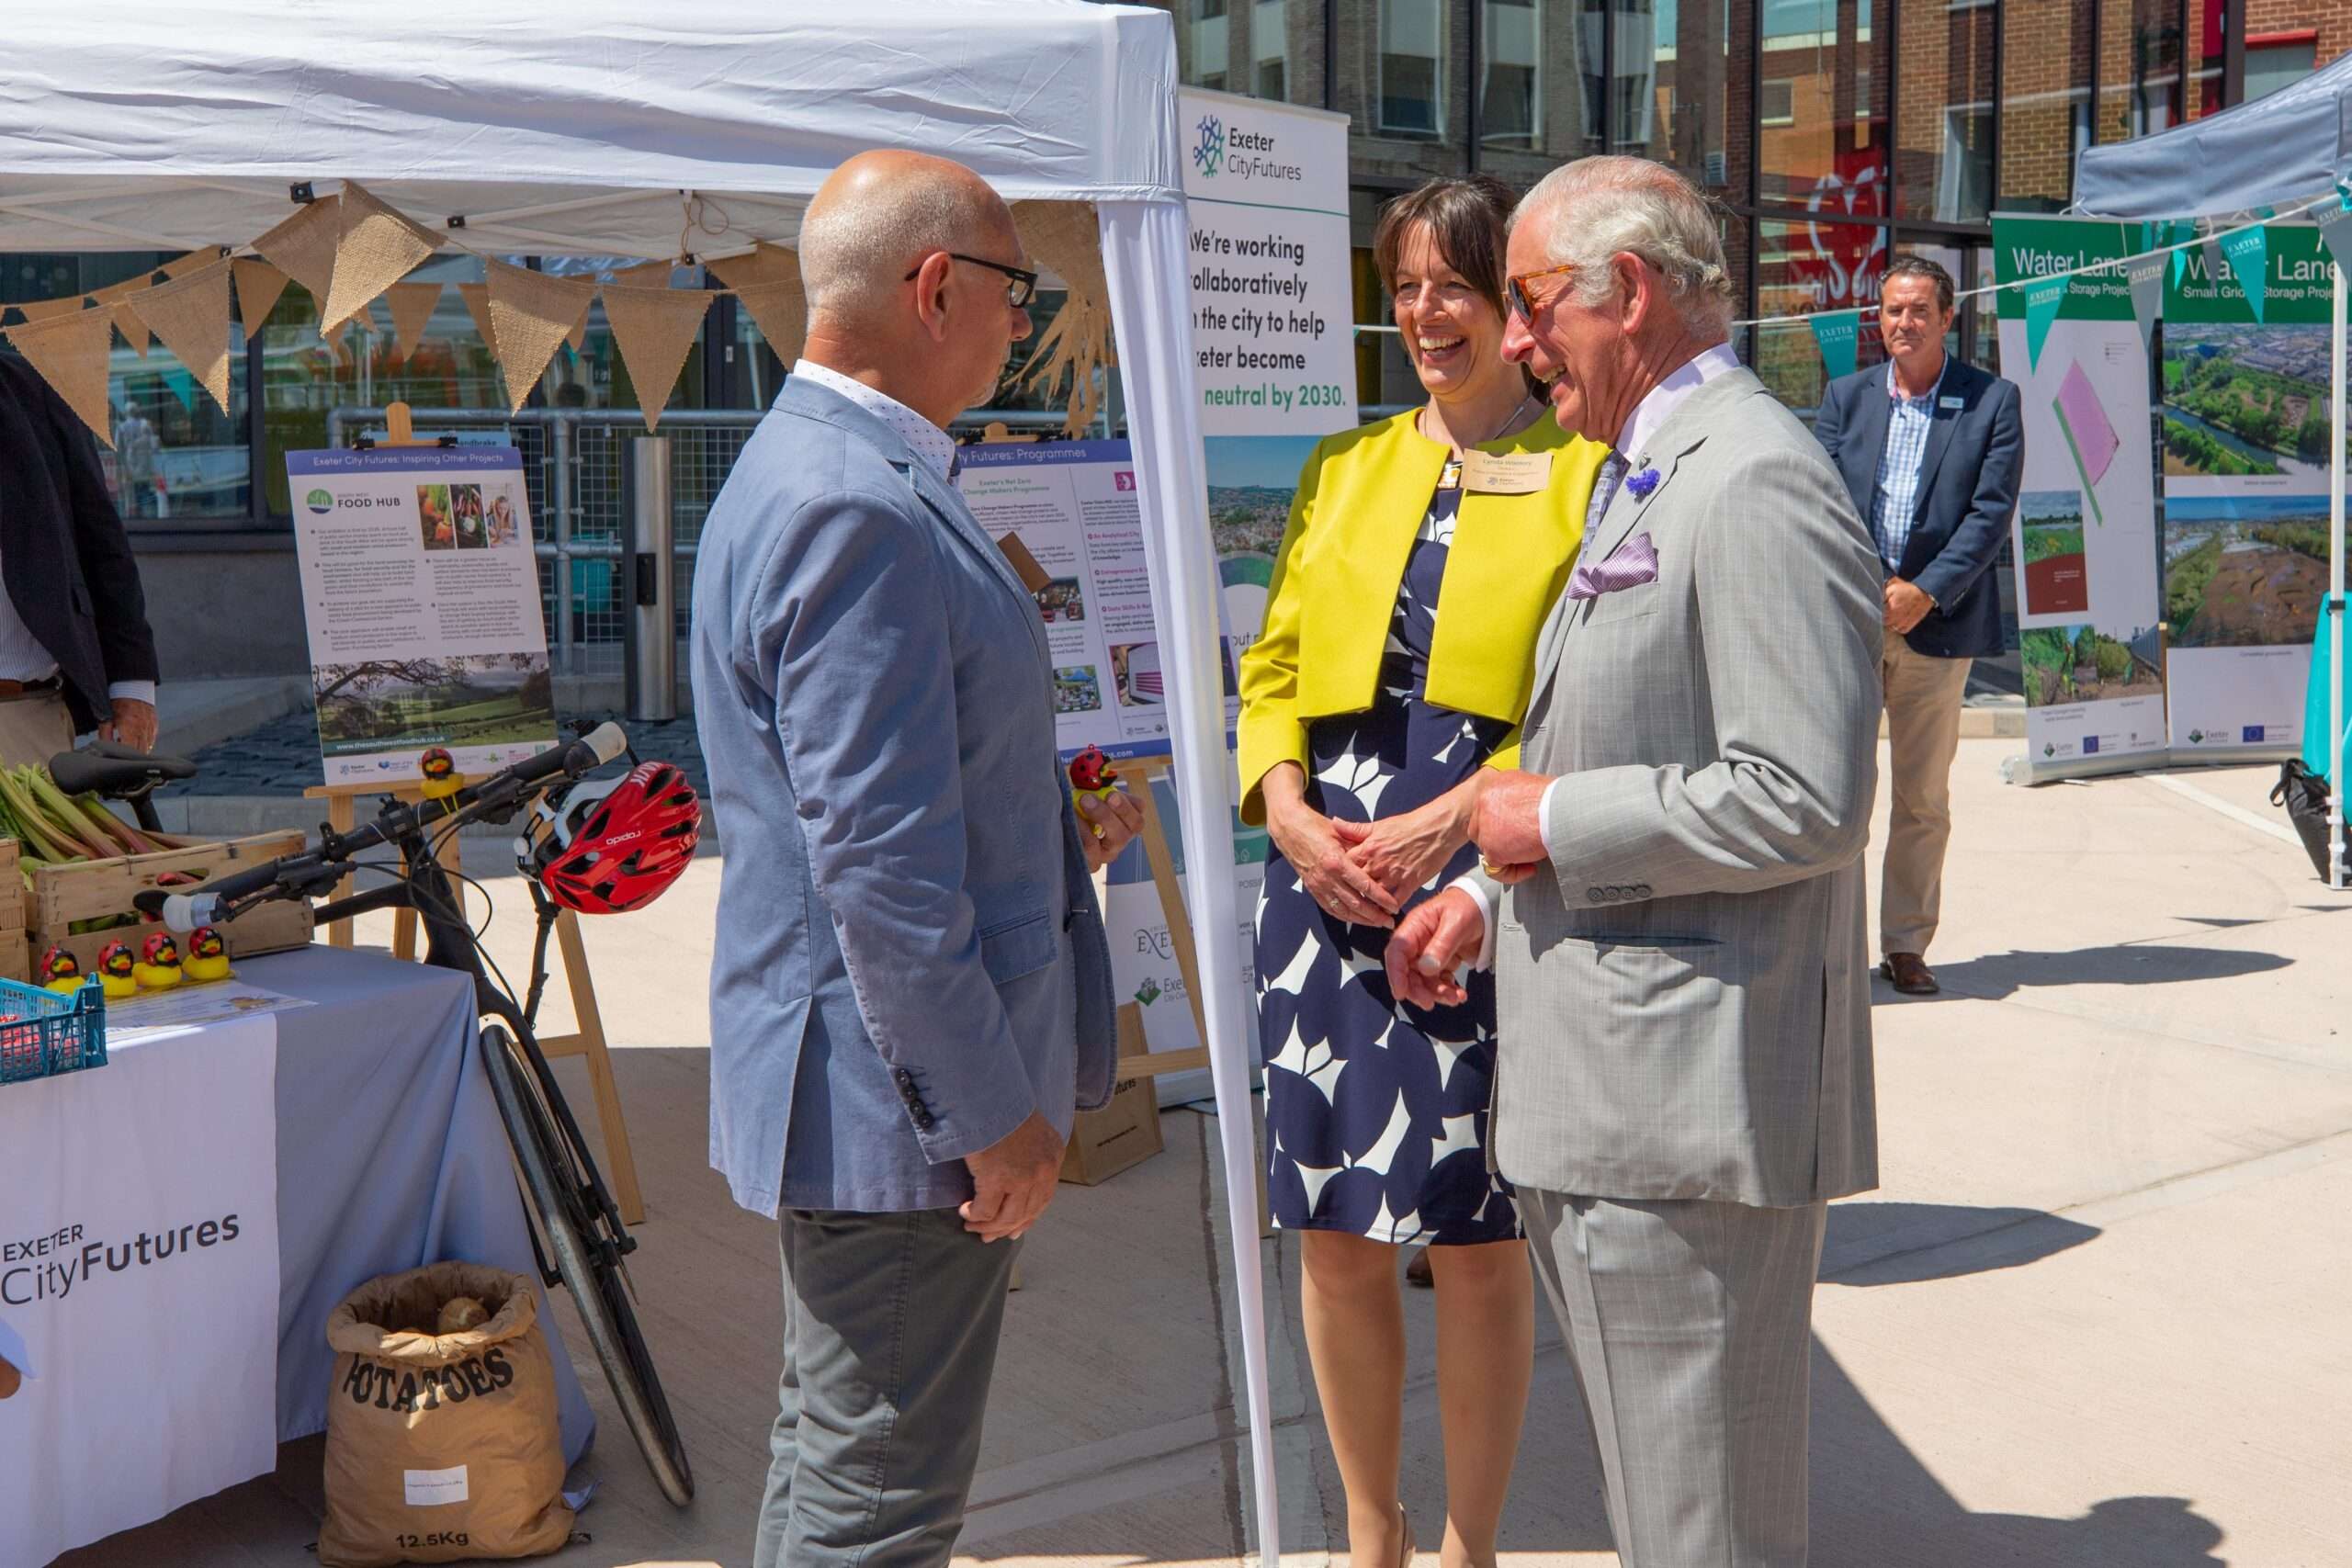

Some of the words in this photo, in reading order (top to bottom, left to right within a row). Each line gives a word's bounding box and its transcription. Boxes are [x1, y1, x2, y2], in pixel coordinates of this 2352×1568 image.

[1229, 128, 1274, 152] Exeter
[1228, 154, 1302, 181] CityFutures
[1236, 234, 1305, 265] working
[2012, 247, 2074, 277] Water
[2079, 249, 2129, 277] Lane
[1191, 267, 1307, 303] ollaboratively
[2069, 282, 2101, 298] Storage
[2102, 283, 2131, 299] Projec
[2263, 287, 2304, 300] Storage
[1202, 306, 1227, 331] the
[1232, 308, 1262, 338] city
[1267, 310, 1283, 333] to
[1289, 310, 1325, 340] help
[1820, 325, 1853, 338] EXETER
[1237, 345, 1306, 369] become
[1204, 382, 1267, 407] neutral
[1272, 383, 1293, 412] by
[1298, 385, 1346, 407] 2030.
[313, 456, 343, 467] Exeter
[345, 455, 363, 467] City
[365, 454, 400, 465] Futures:
[402, 454, 441, 466] Inspiring
[442, 453, 468, 463] Other
[469, 453, 503, 464] Projects
[971, 450, 1014, 462] Futures:
[1017, 447, 1087, 463] Programmes
[337, 498, 372, 508] FOOD
[376, 497, 401, 507] HUB
[336, 736, 446, 750] www.thesouthwestfoodhub.co.uk
[605, 831, 641, 846] rapido
[1134, 929, 1174, 960] EXE
[1164, 977, 1184, 993] Exe
[3, 1224, 84, 1262] EXETER
[1, 1213, 240, 1305] CityFutures
[395, 1530, 469, 1549] 12.5Kg
